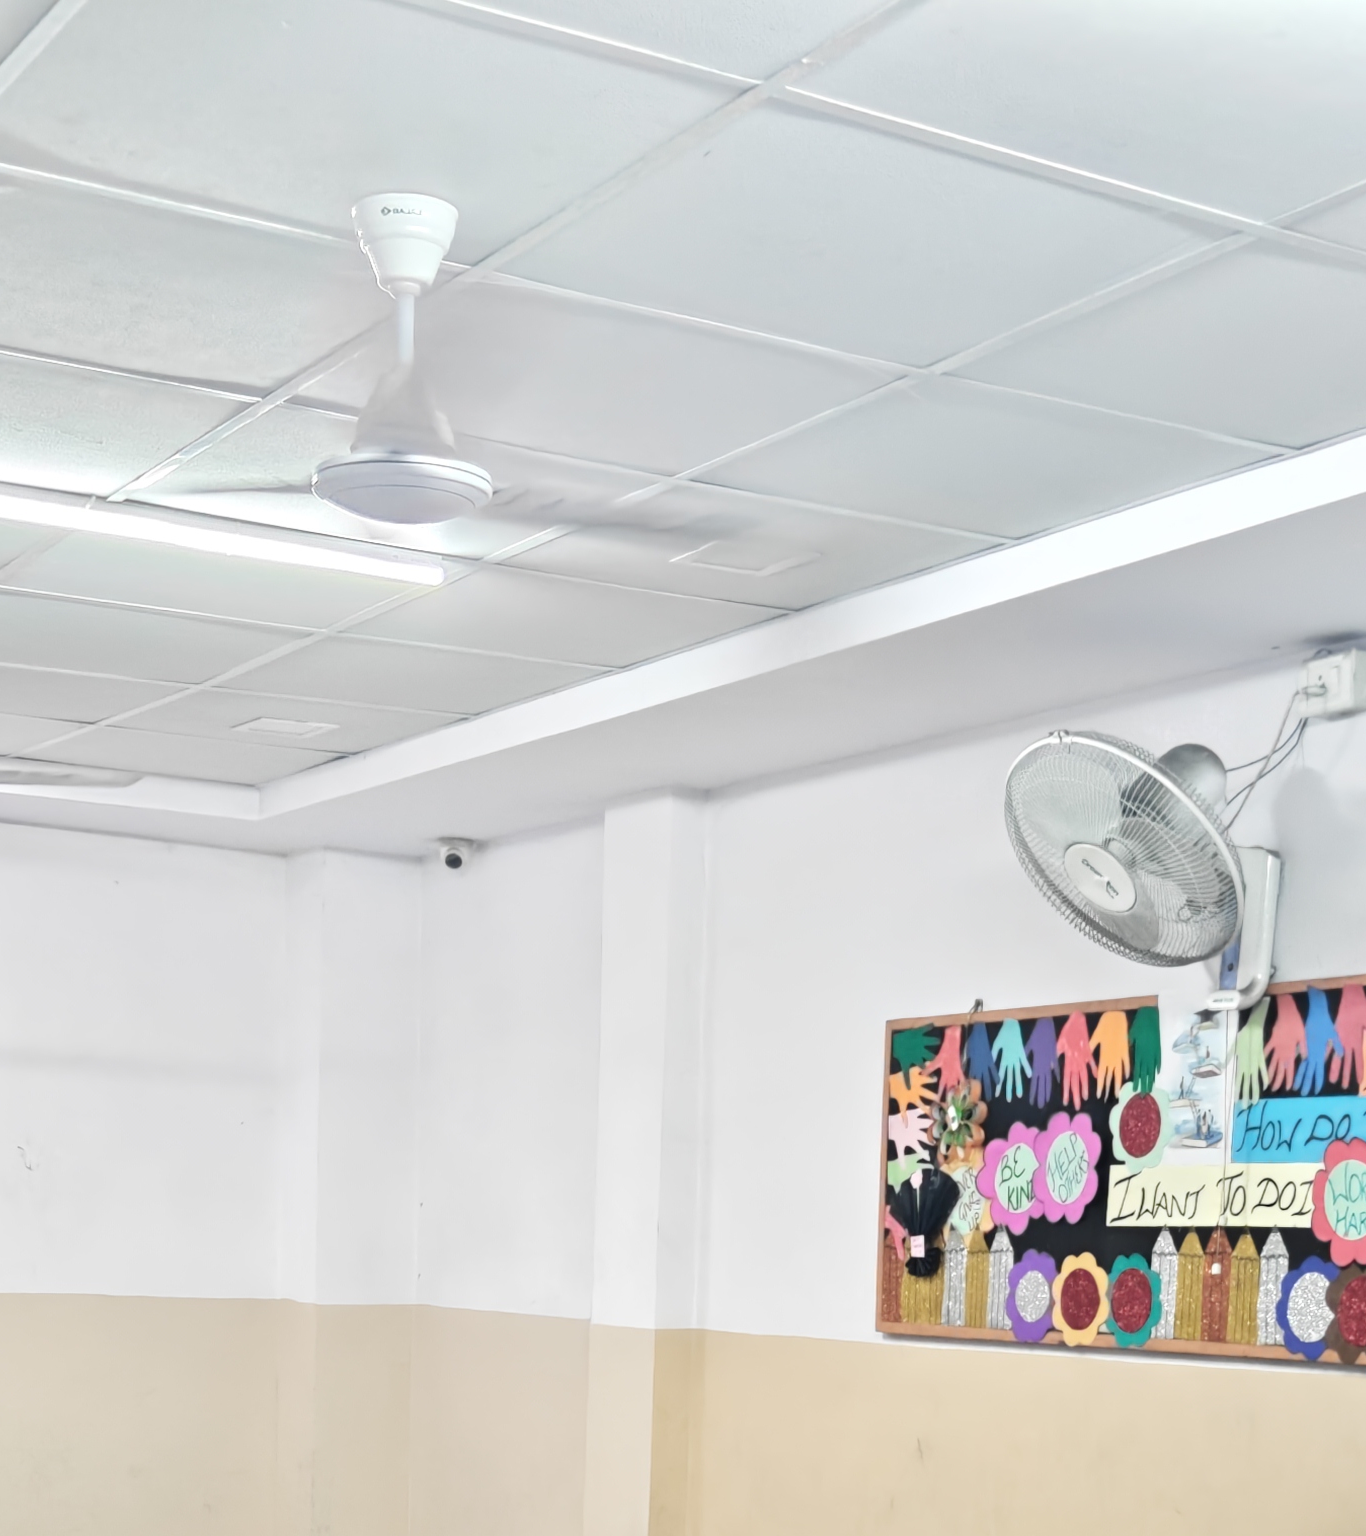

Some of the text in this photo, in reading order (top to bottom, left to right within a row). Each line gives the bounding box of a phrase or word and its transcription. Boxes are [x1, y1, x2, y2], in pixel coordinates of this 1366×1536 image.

[1235, 1100, 1302, 1152] HOW
[1304, 1114, 1352, 1146] DO
[999, 1145, 1026, 1187] BE
[1047, 1132, 1078, 1193] HELP
[1109, 1171, 1142, 1223] I
[1135, 1181, 1206, 1221] WANT
[1215, 1170, 1247, 1217] TO
